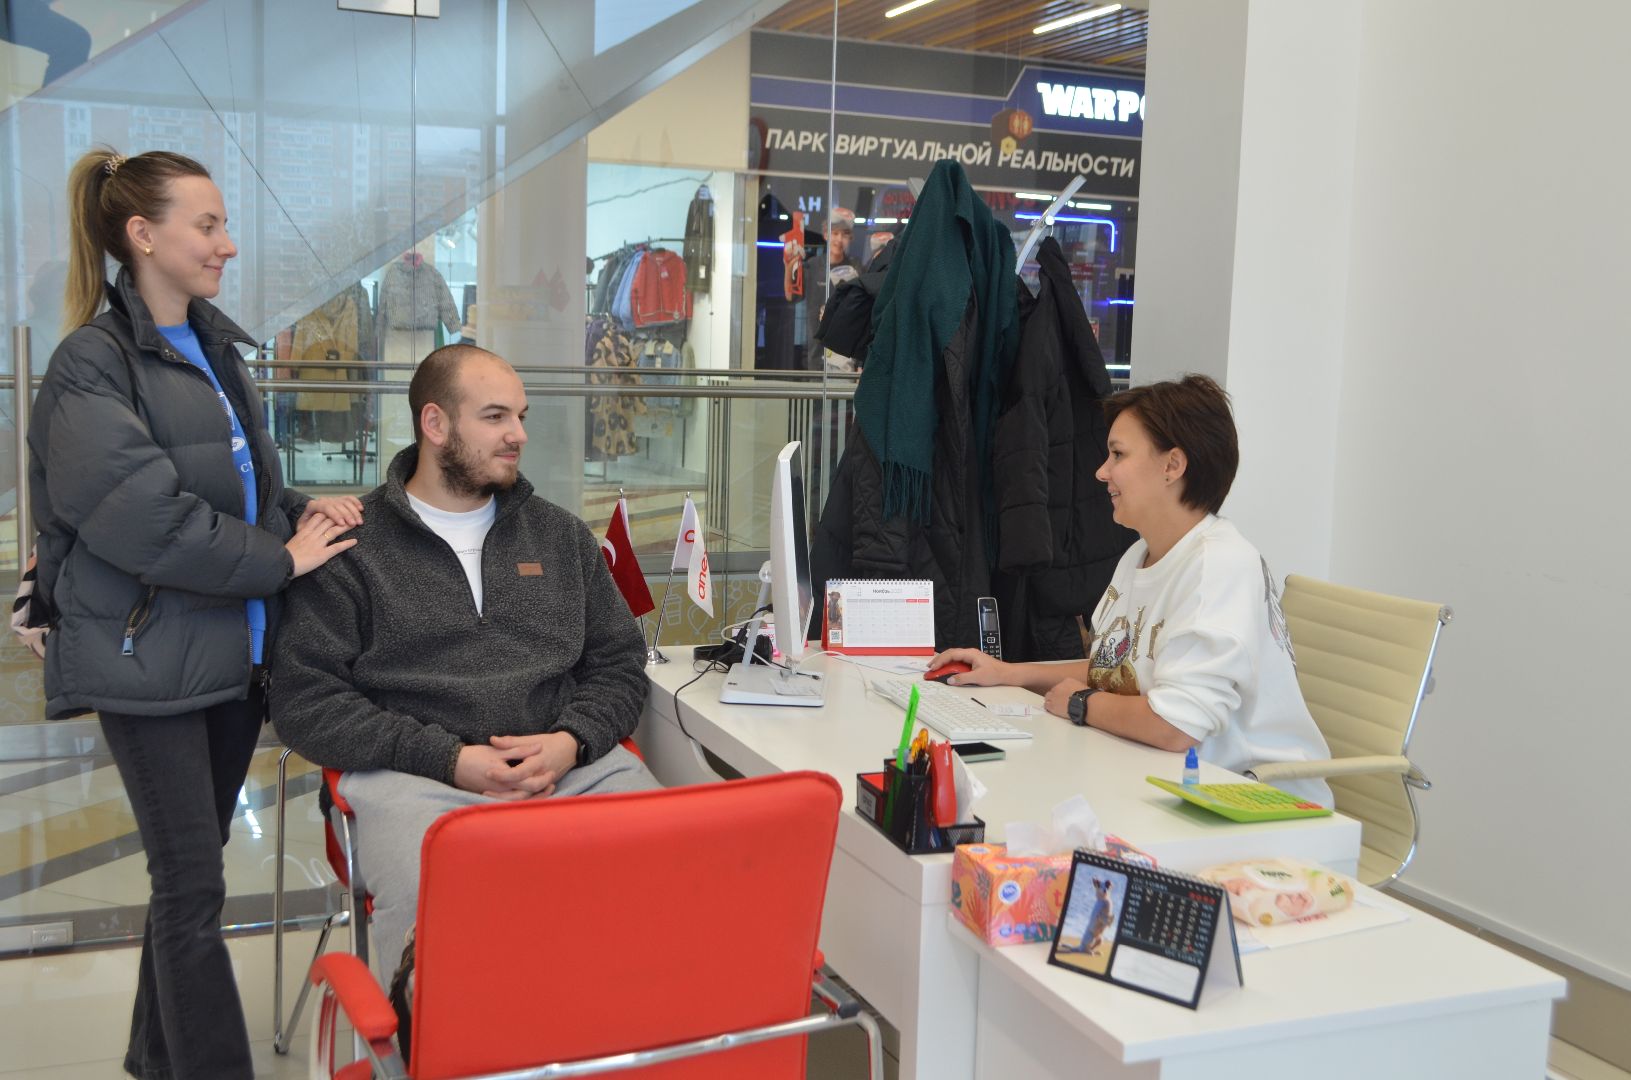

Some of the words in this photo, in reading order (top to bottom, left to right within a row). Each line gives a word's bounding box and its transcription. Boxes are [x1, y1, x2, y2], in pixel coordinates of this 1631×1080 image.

[765, 128, 828, 153] ПАРК
[835, 133, 993, 167] ВИРТУАЛЬНОЙ
[998, 148, 1136, 178] РЕАЛЬНОСТИ
